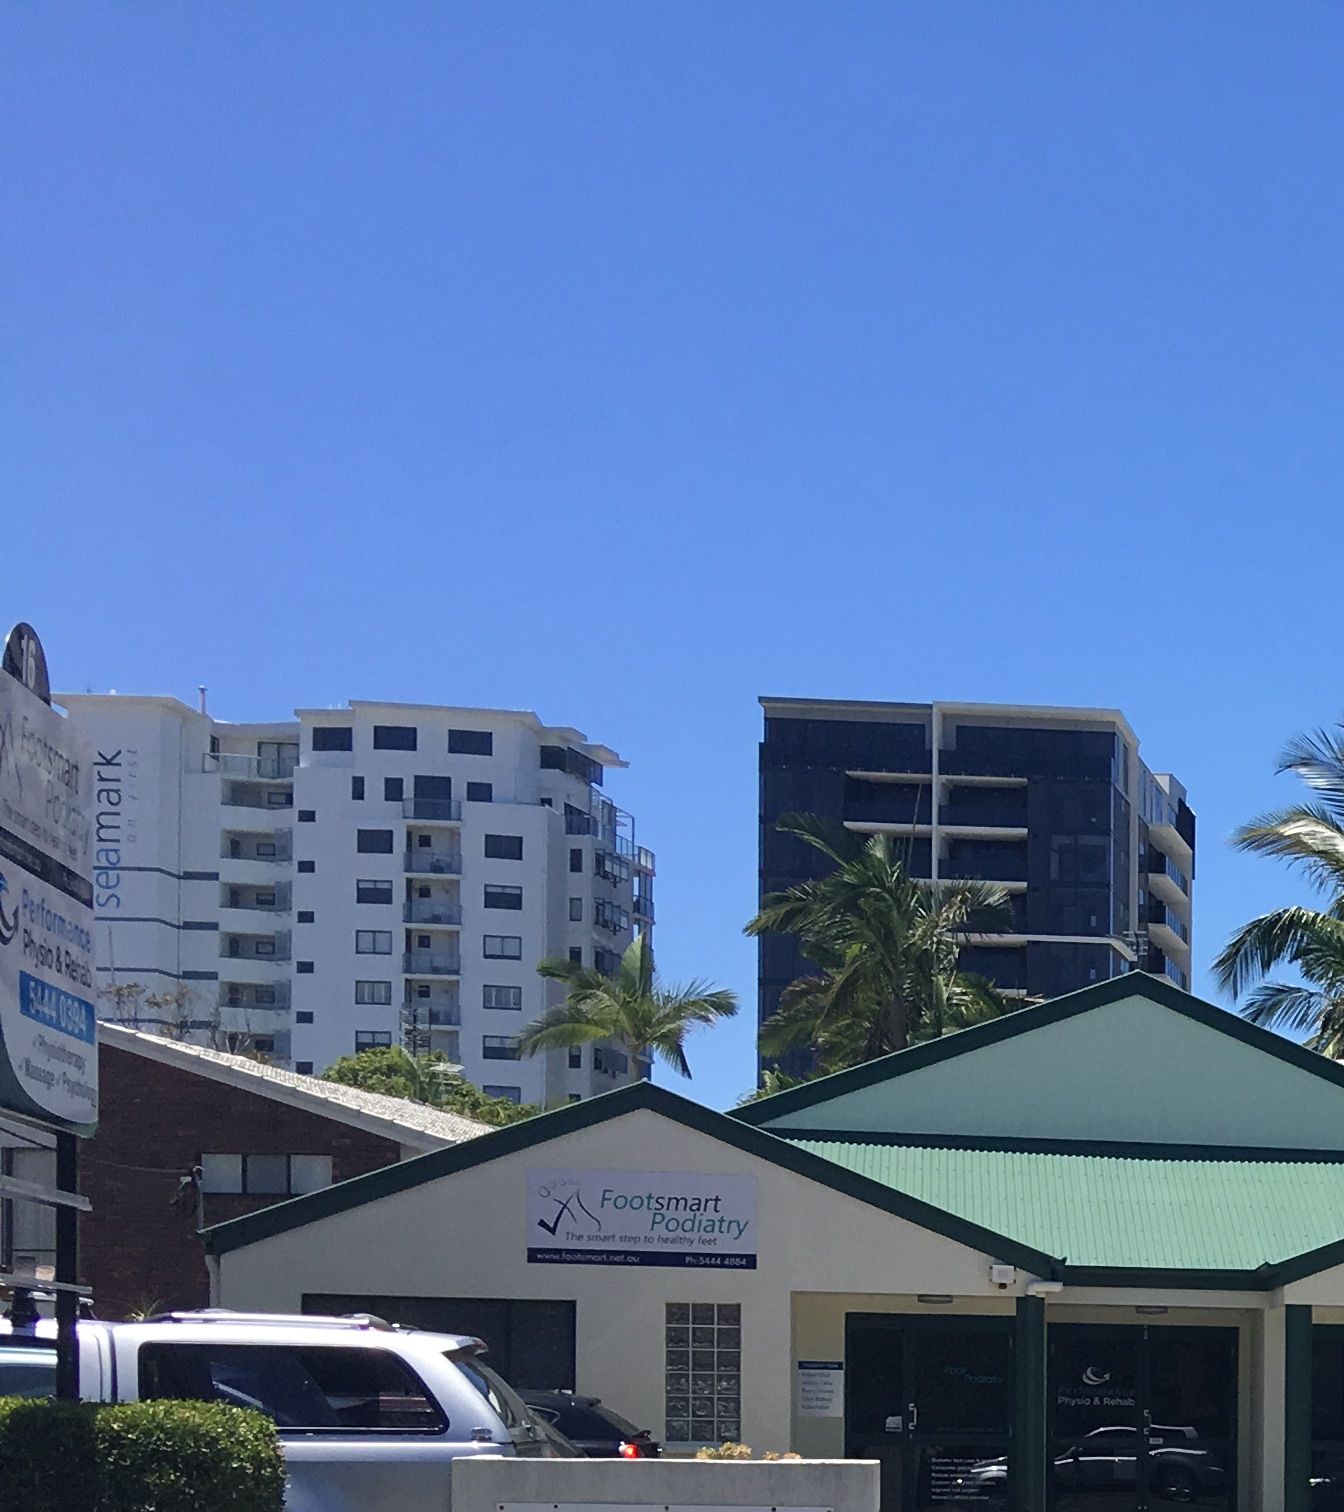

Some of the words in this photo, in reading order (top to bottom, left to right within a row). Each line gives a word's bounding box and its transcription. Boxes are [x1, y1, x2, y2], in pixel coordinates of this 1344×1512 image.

[21, 634, 36, 689] 16
[93, 749, 122, 908] seamark
[600, 1188, 722, 1213] Footsmart
[565, 1231, 584, 1241] The
[587, 1233, 616, 1243] smart
[619, 1234, 641, 1245] step
[644, 1235, 655, 1244] to
[658, 1235, 695, 1248] healthy
[698, 1236, 717, 1246] feet
[650, 1212, 749, 1240] Podiatry
